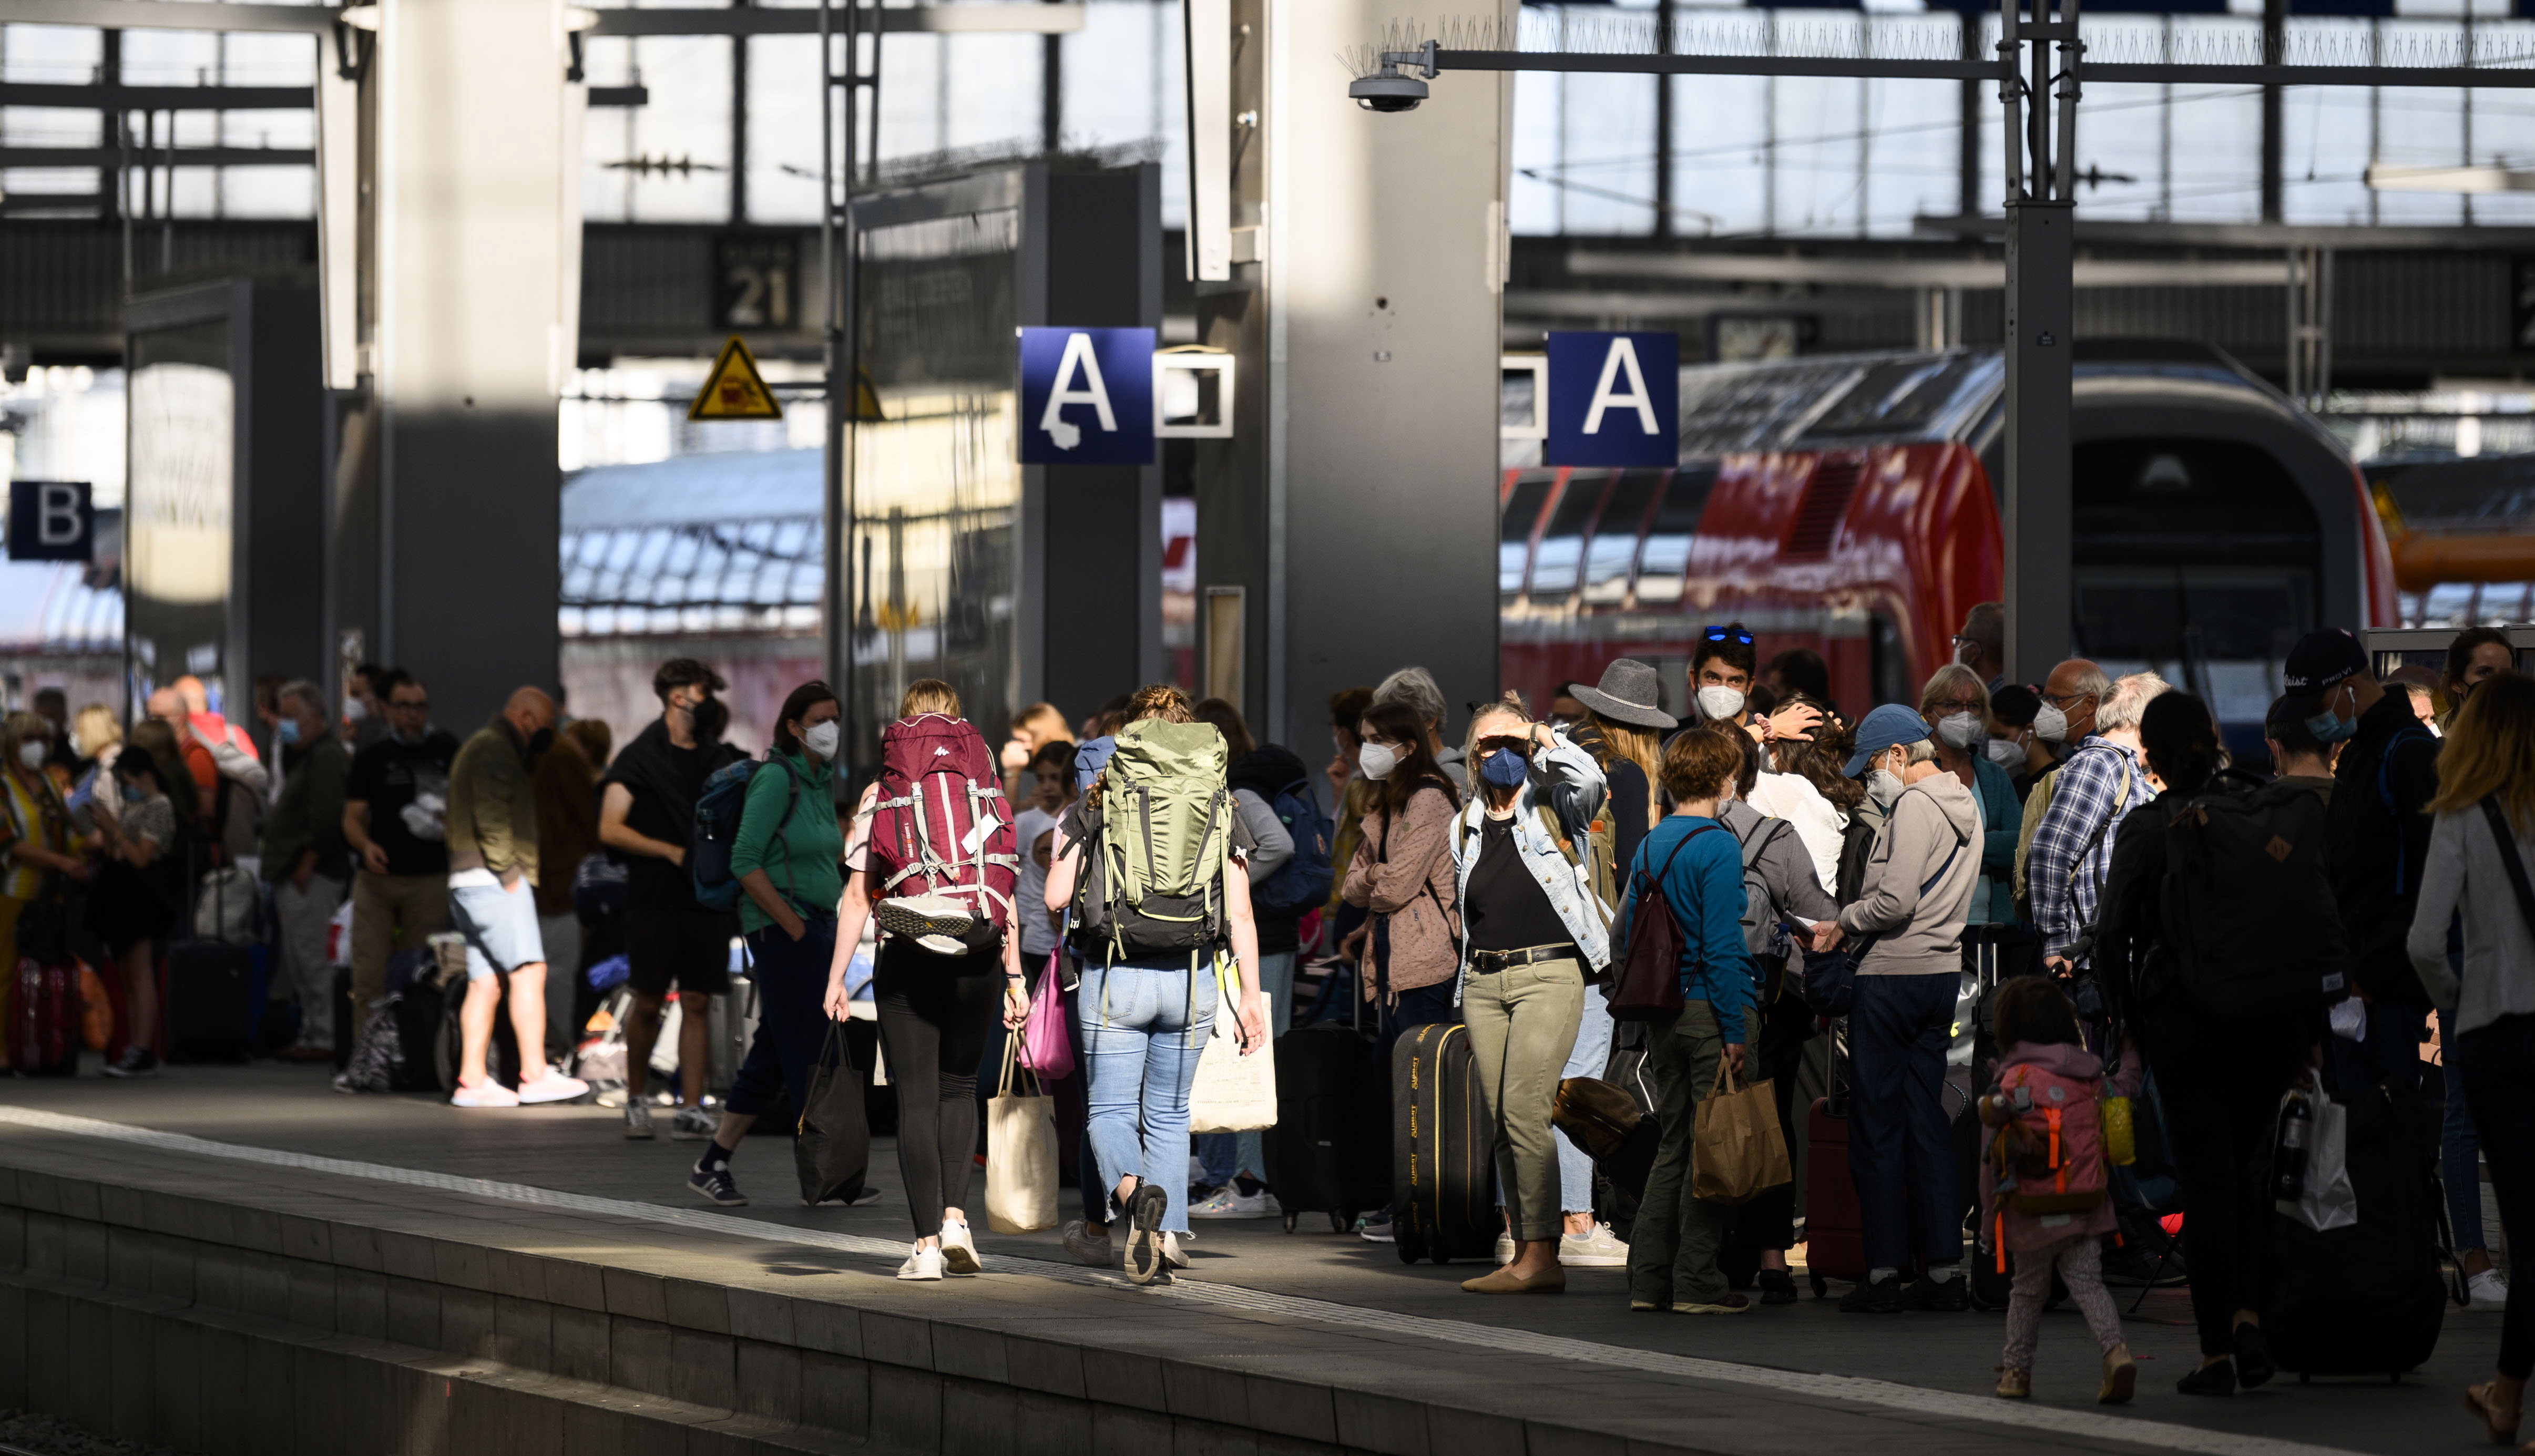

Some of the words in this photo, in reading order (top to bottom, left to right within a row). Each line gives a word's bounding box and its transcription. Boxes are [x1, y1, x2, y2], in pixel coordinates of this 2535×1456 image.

[728, 267, 790, 325] 21
[1039, 332, 1118, 432] A
[1582, 336, 1660, 435] A
[38, 484, 83, 546] B
[1411, 1057, 1419, 1090] SUMMIT
